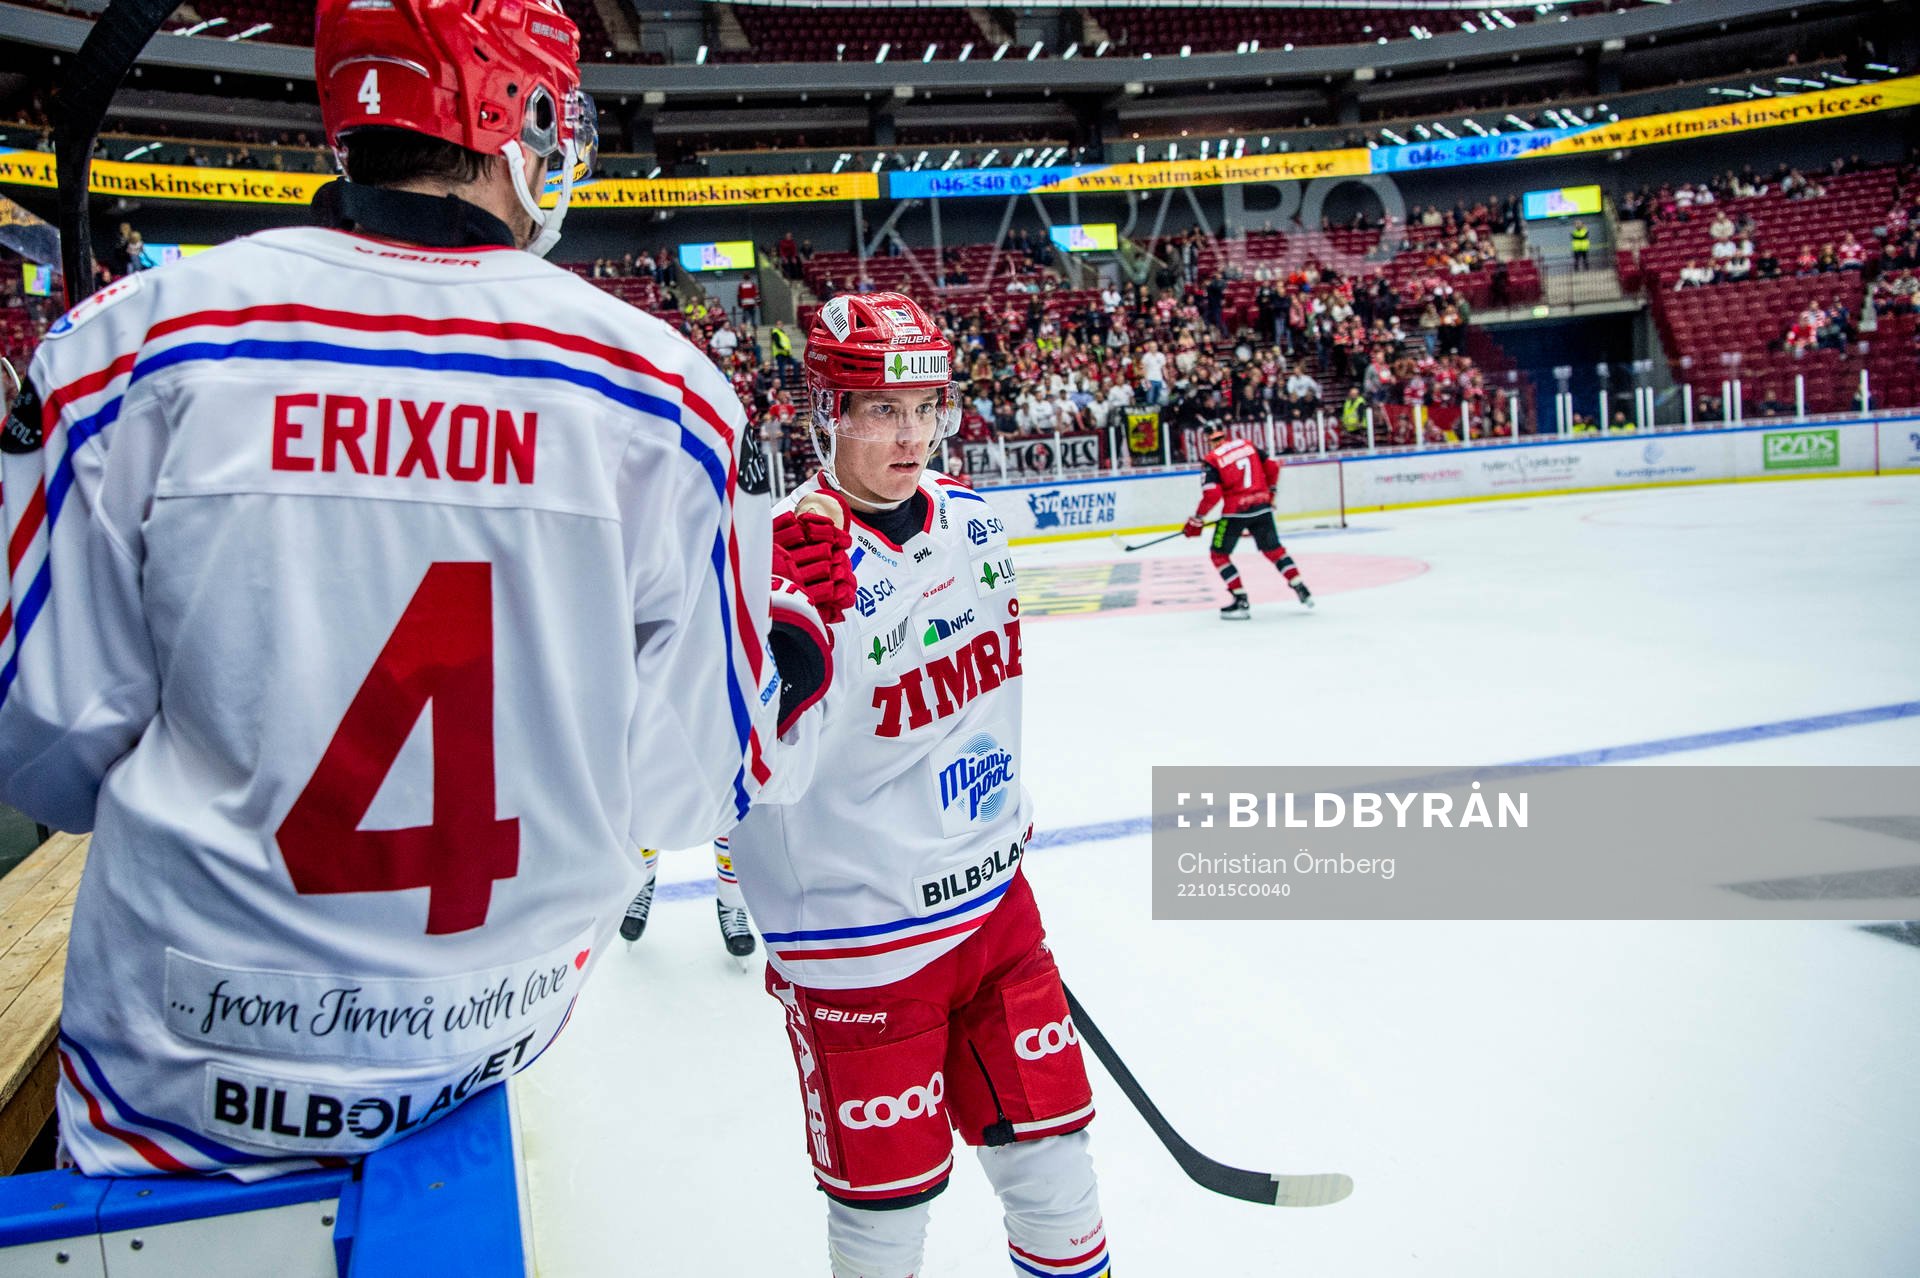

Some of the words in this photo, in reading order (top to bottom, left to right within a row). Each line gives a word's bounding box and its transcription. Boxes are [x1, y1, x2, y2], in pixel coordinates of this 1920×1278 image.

[357, 69, 381, 114] 4
[890, 335, 932, 345] BAUER
[271, 393, 539, 486] ERIXON
[1235, 457, 1253, 489] 7
[1063, 510, 1092, 527] TELE
[1097, 507, 1115, 522] AB
[913, 546, 932, 564] SHL
[873, 577, 897, 602] SCA
[951, 608, 975, 634] NHC
[274, 561, 520, 936] 4
[939, 748, 1007, 812] Miami
[969, 754, 1015, 822] pool
[201, 980, 301, 1034] from
[309, 986, 435, 1041] Timrå
[444, 978, 514, 1032] with
[519, 963, 569, 1016] love
[814, 1007, 888, 1025] BAUER
[1013, 1014, 1078, 1061] coo
[214, 1030, 537, 1140] BILBOLAGET
[838, 1070, 945, 1130] coop
